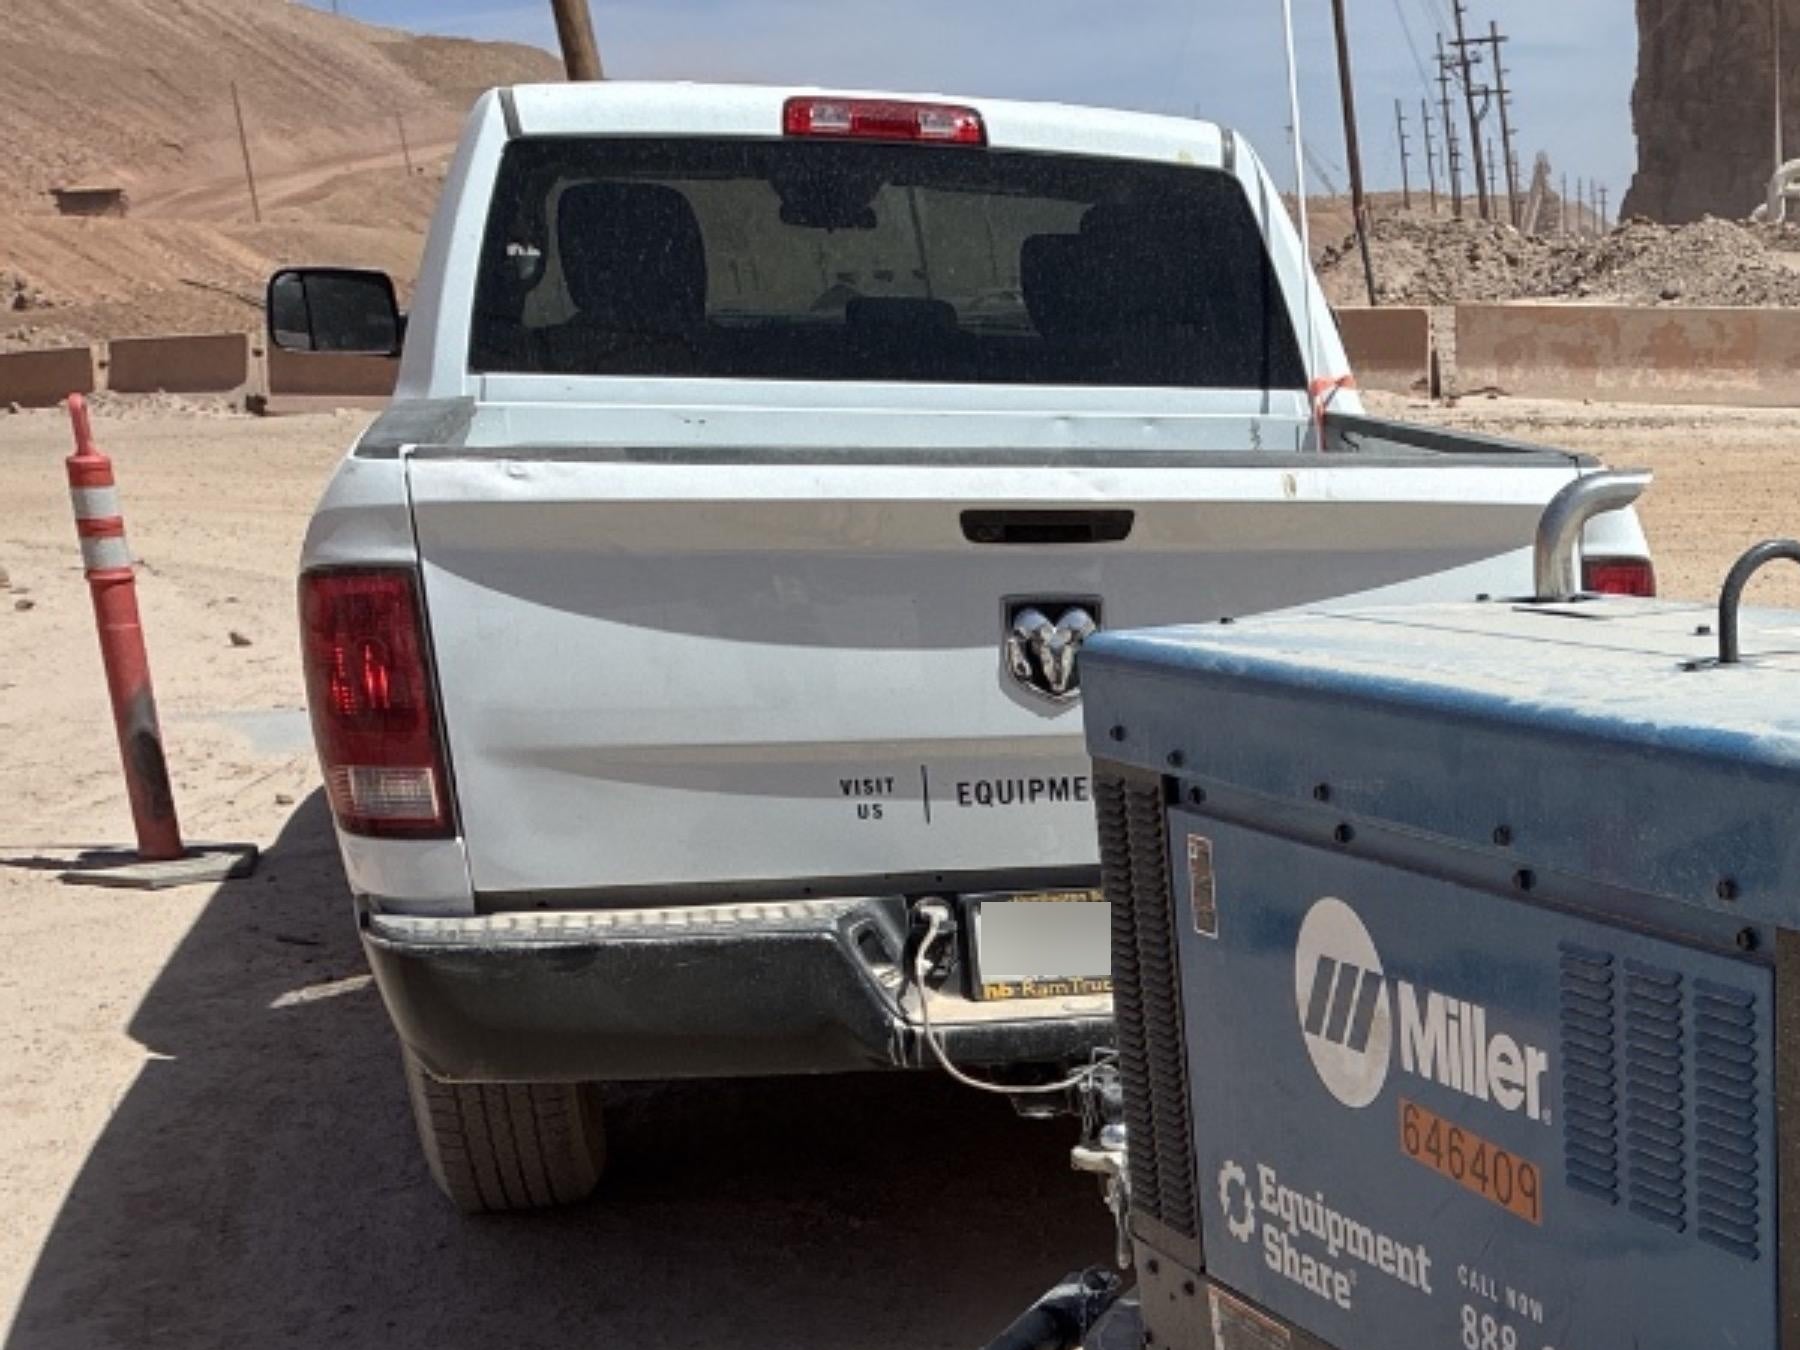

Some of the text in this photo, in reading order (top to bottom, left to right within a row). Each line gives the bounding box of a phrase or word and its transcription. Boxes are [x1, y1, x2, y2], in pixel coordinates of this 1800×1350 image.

[840, 777, 895, 796] VISIT
[857, 803, 883, 820] US
[956, 776, 1089, 807] EQUIPME
[1397, 979, 1549, 1121] Miller
[1402, 1103, 1538, 1220] 646409
[1256, 1163, 1433, 1296] Equipment
[1262, 1223, 1351, 1309] Share
[1457, 1263, 1543, 1324] CALL NOW
